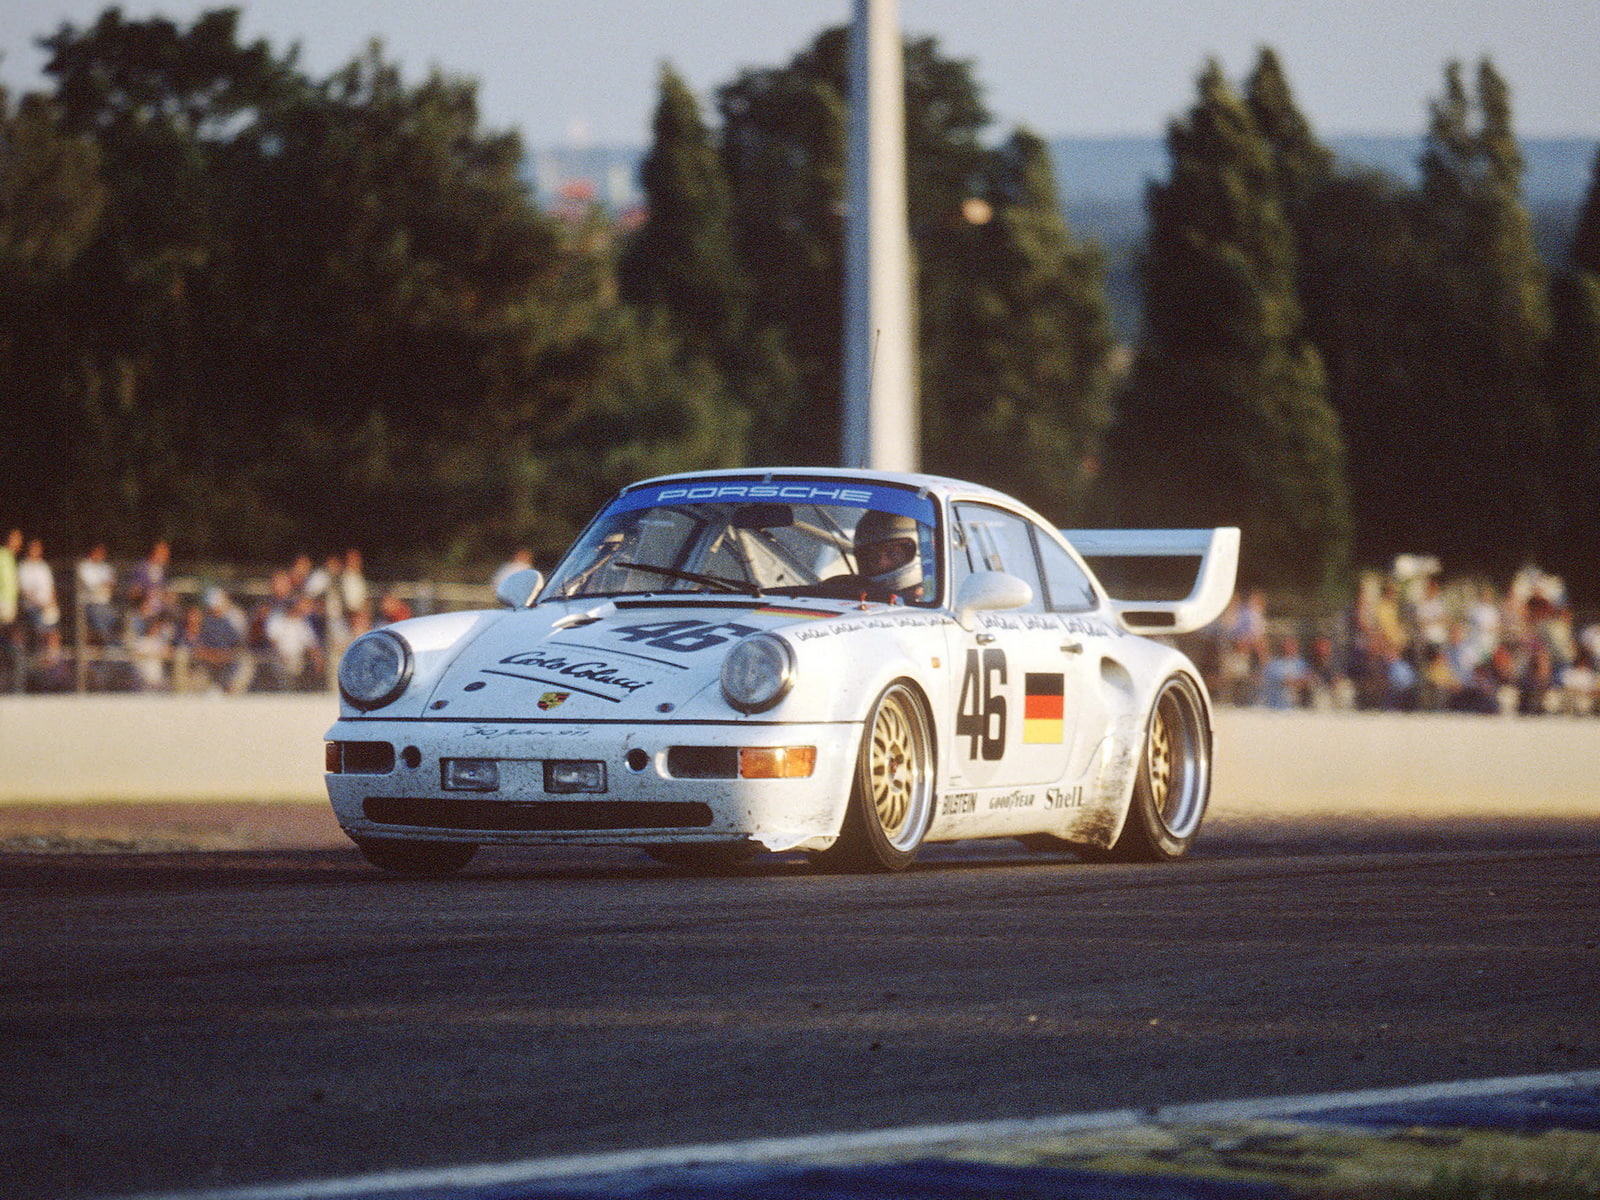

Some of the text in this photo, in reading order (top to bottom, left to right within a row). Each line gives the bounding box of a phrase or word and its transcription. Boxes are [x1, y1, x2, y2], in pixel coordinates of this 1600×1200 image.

[657, 486, 872, 502] PORSCHE
[610, 619, 762, 653] 46
[499, 652, 567, 670] Carlo
[559, 662, 653, 694] Colucci
[956, 648, 1007, 761] 46
[942, 792, 978, 816] BILSTEIN
[988, 790, 1036, 811] GOODYEAR
[1044, 786, 1083, 810] Shell
